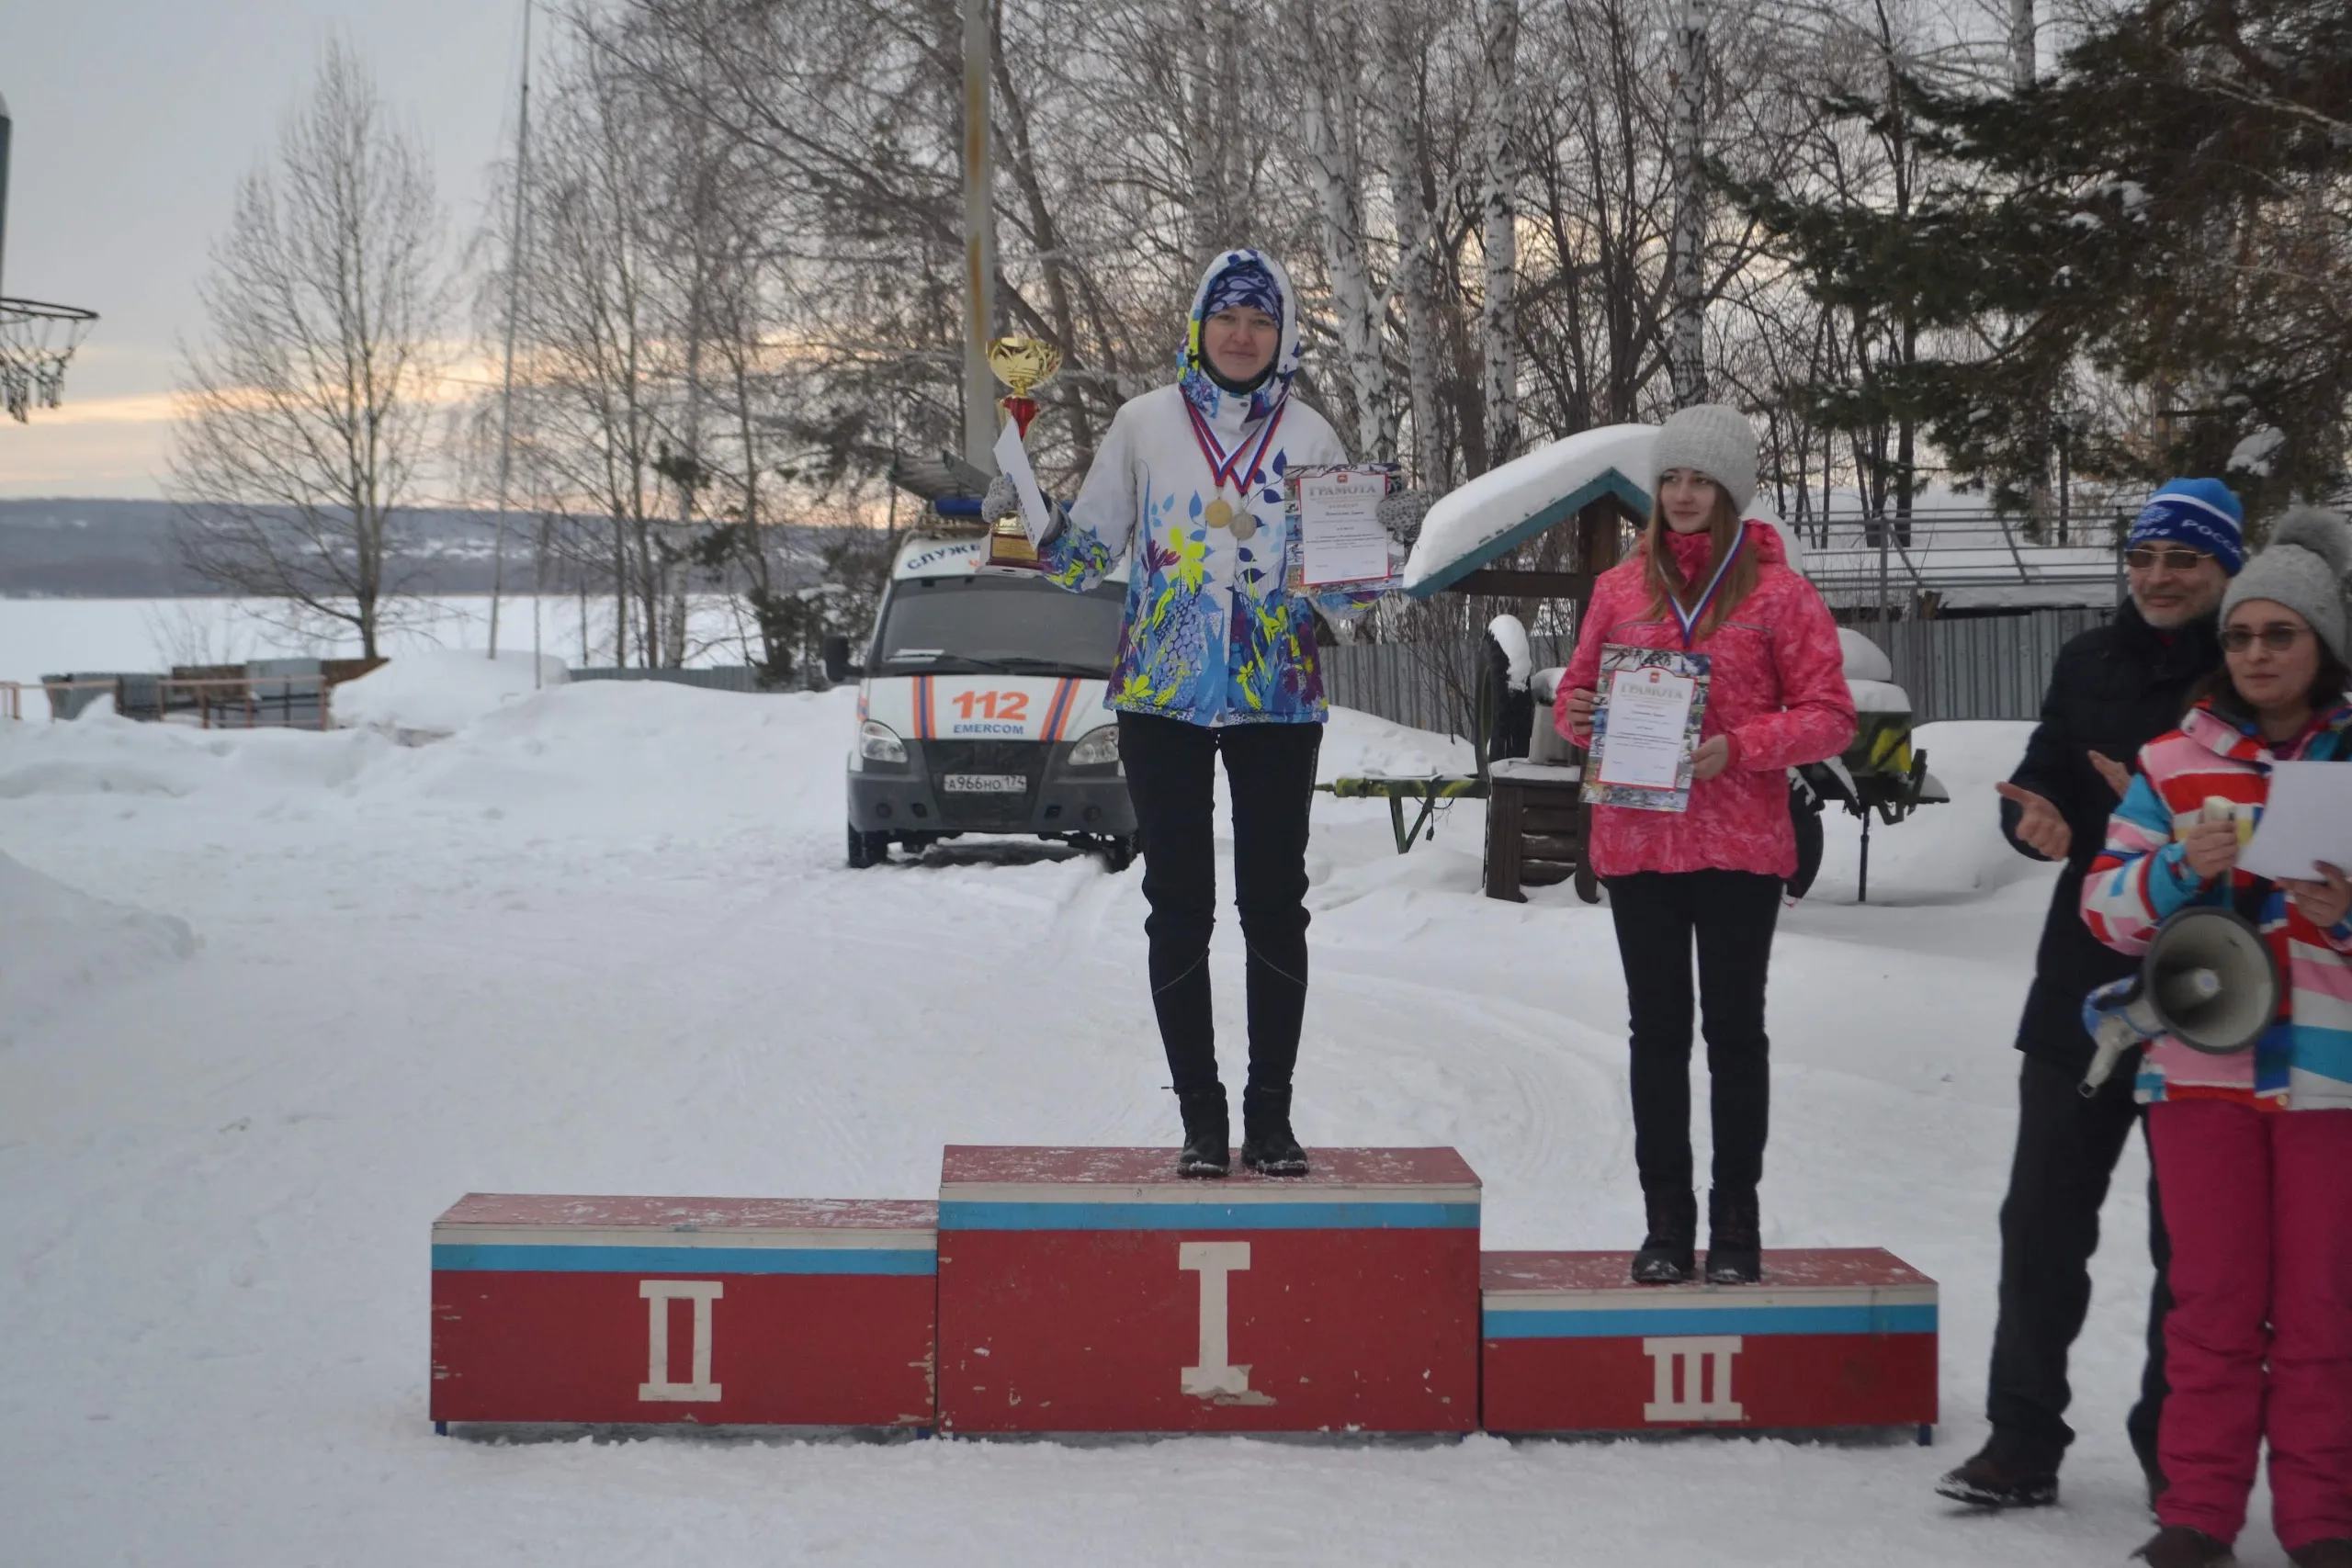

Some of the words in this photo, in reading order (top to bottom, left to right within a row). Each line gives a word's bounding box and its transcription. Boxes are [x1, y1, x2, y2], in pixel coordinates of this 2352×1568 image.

[1308, 483, 1376, 497] ГРАМОТА
[952, 691, 1029, 720] 112
[1621, 682, 1684, 700] ГРАМОТА
[953, 724, 1024, 735] EMERCOM
[1179, 1242, 1252, 1399] I
[639, 1280, 724, 1402] II
[1643, 1336, 1743, 1421] III
